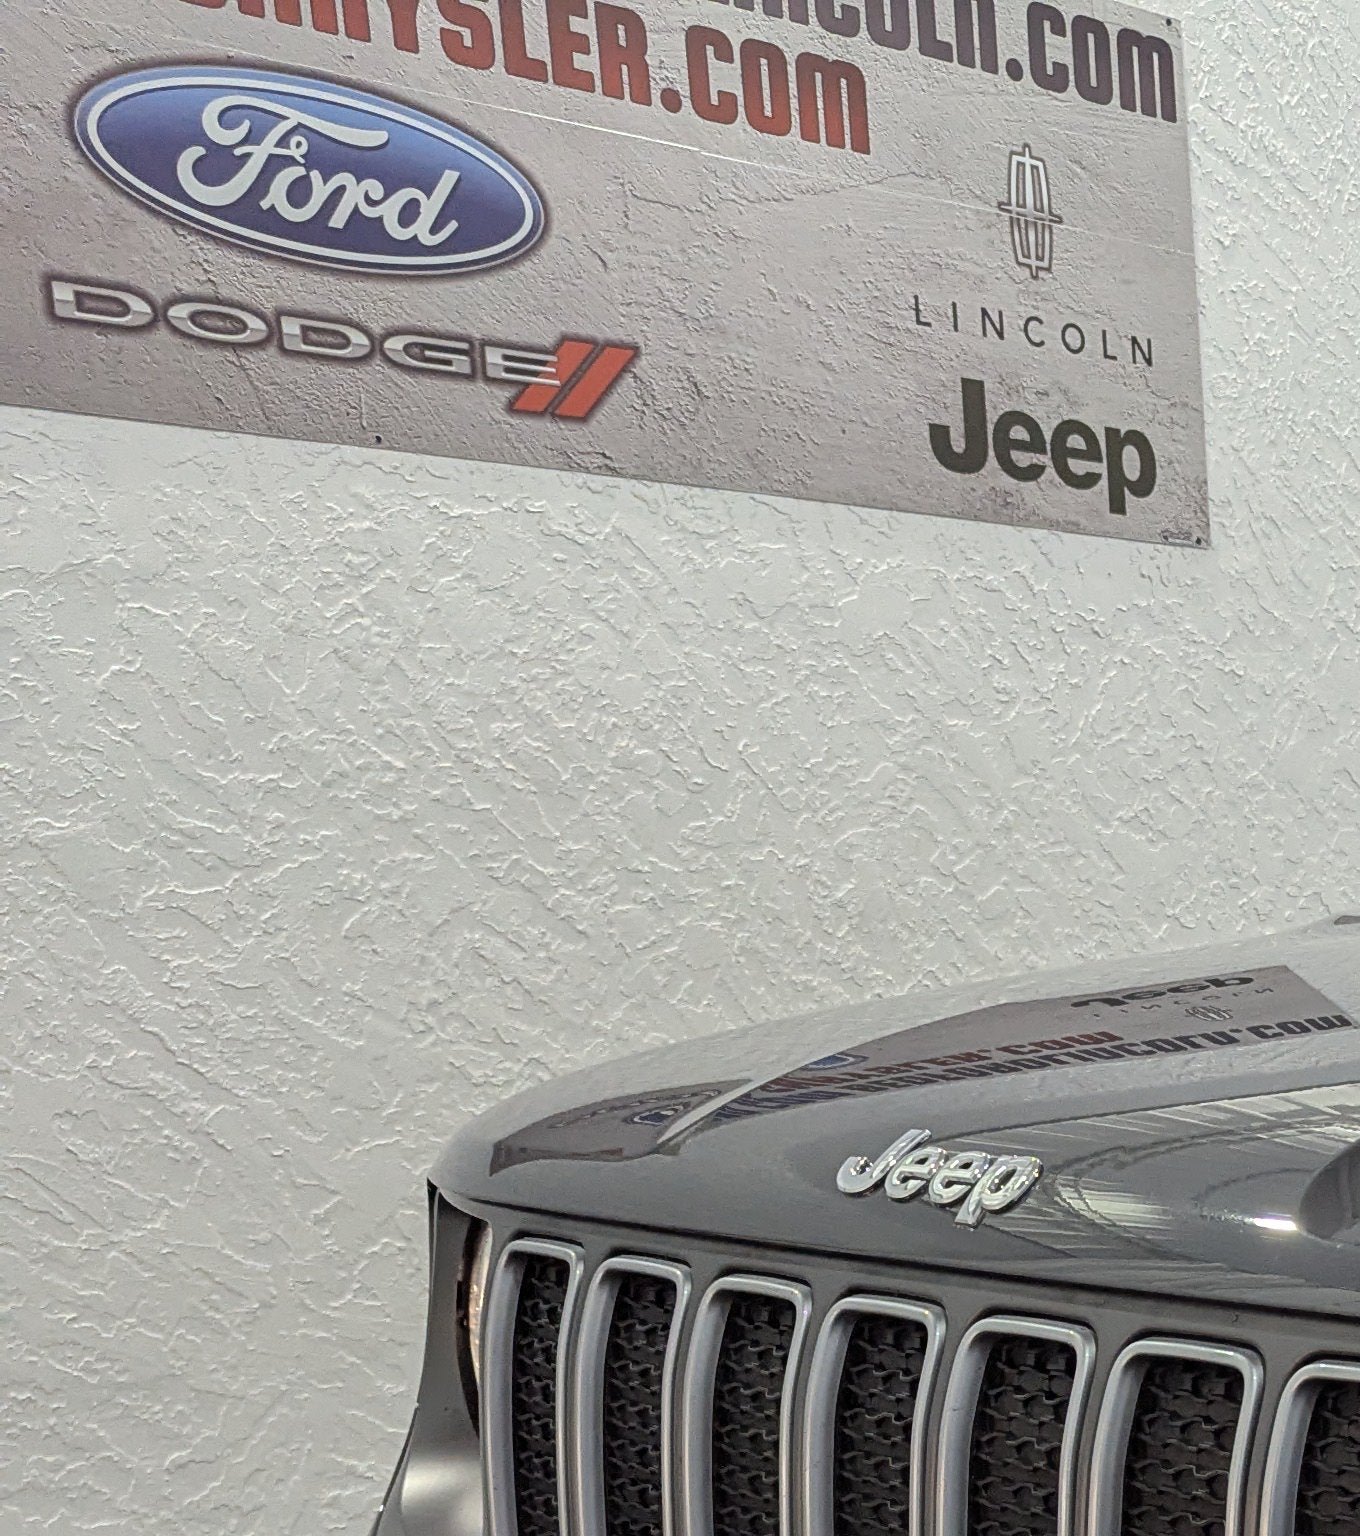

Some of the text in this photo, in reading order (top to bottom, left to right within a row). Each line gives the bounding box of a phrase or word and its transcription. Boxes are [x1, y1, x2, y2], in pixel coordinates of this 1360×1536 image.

[176, 94, 459, 247] Ford
[50, 280, 563, 388] DODGE
[913, 294, 1154, 368] LINCOLN
[928, 377, 1157, 516] Jeep
[836, 1129, 1044, 1229] Jeep
